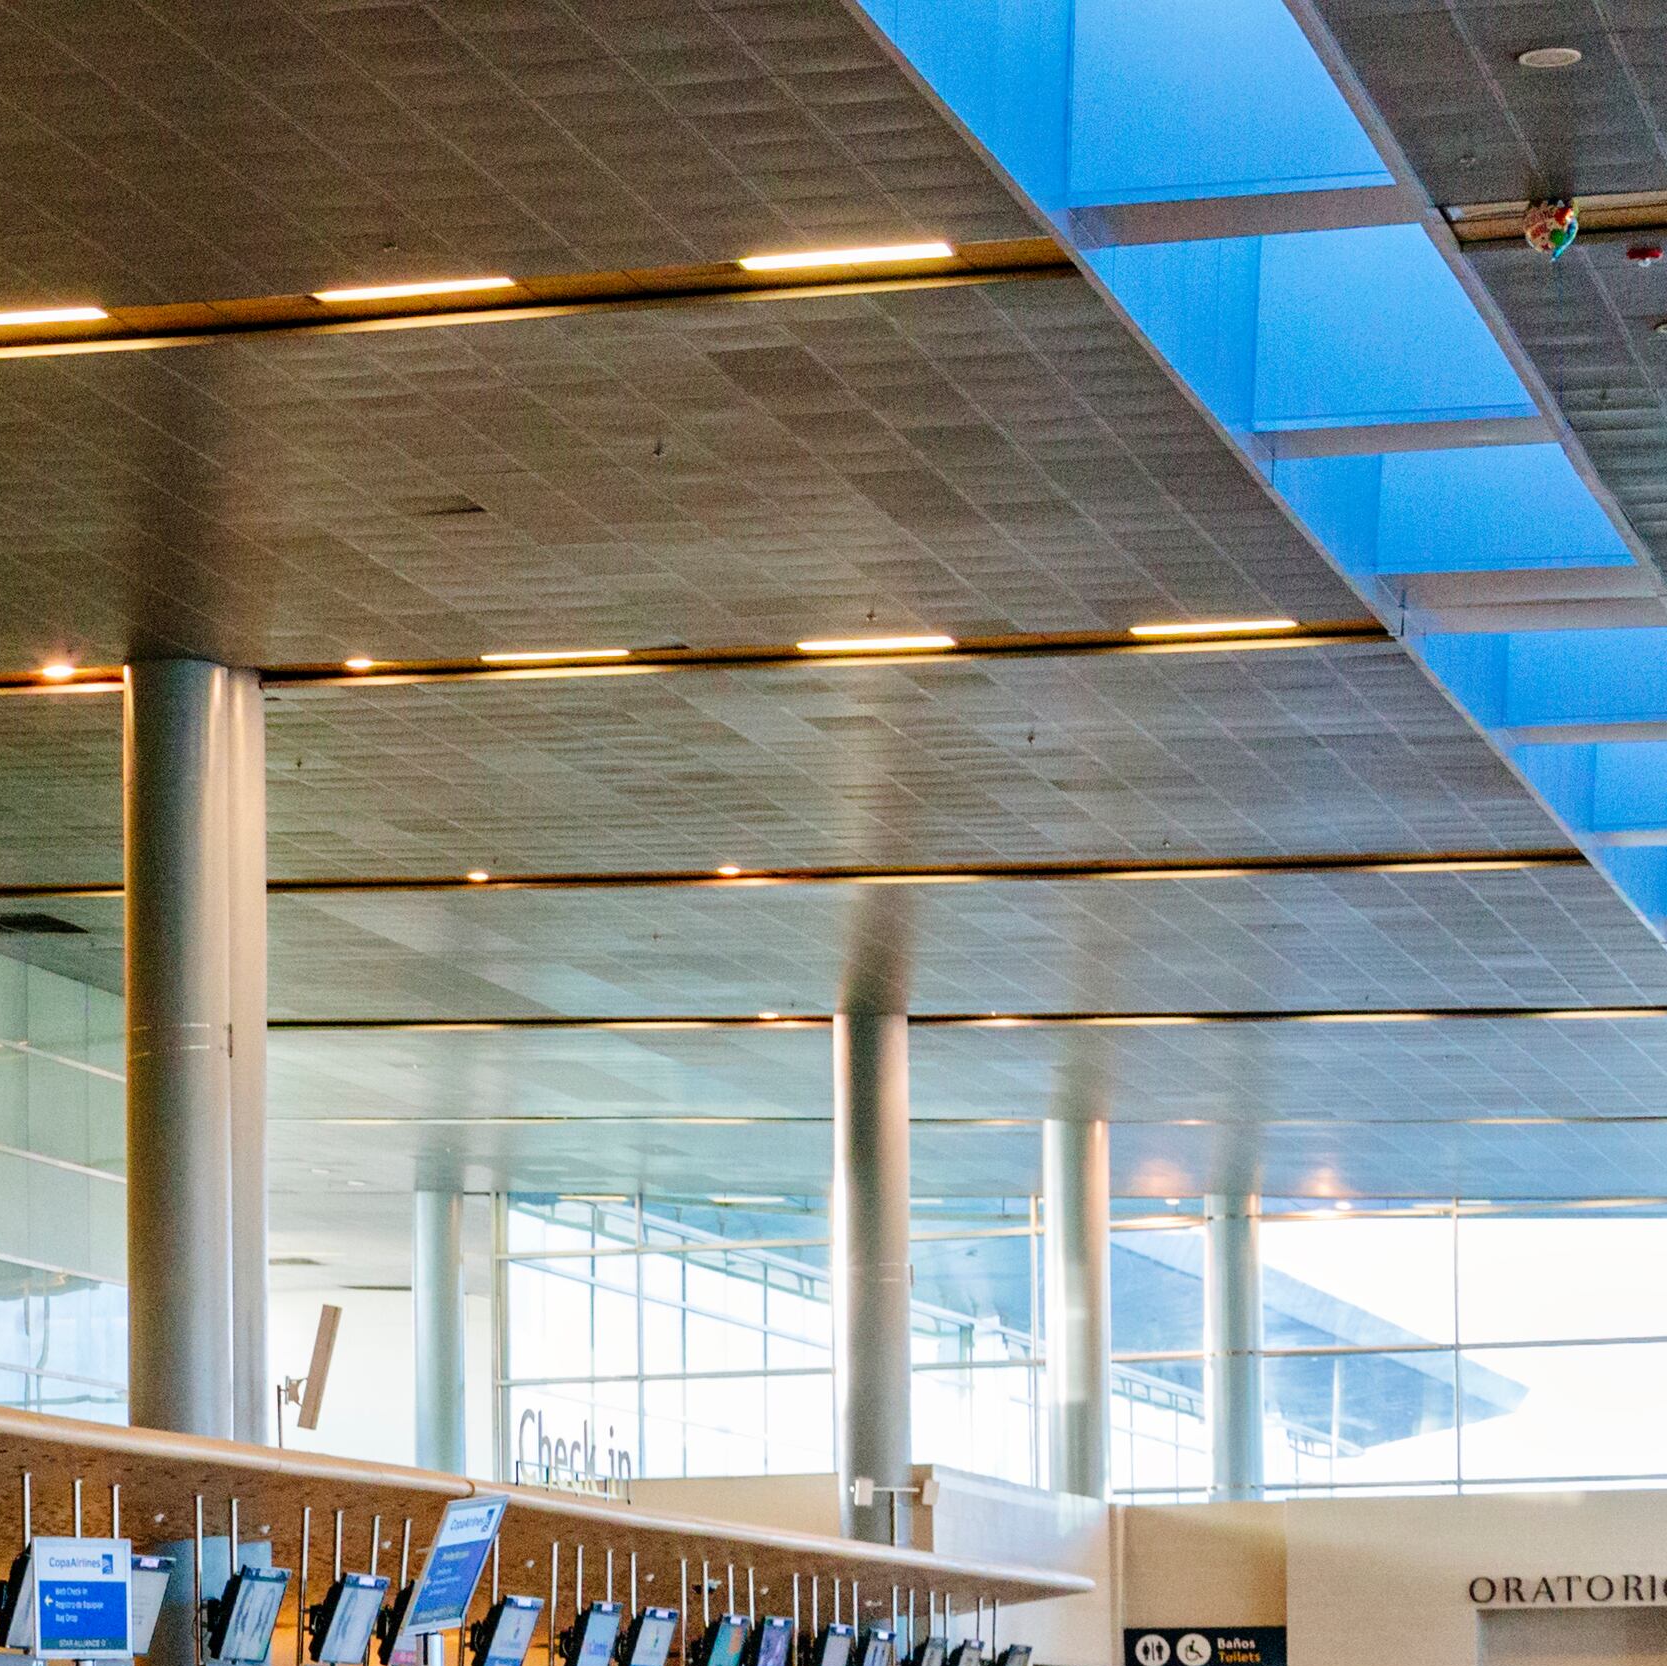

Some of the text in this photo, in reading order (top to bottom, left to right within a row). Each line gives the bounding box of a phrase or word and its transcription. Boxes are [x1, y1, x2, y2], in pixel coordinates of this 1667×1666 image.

[519, 1409, 632, 1502] Check in
[1217, 1636, 1256, 1651] Baños
[1218, 1650, 1261, 1663] Toilets
